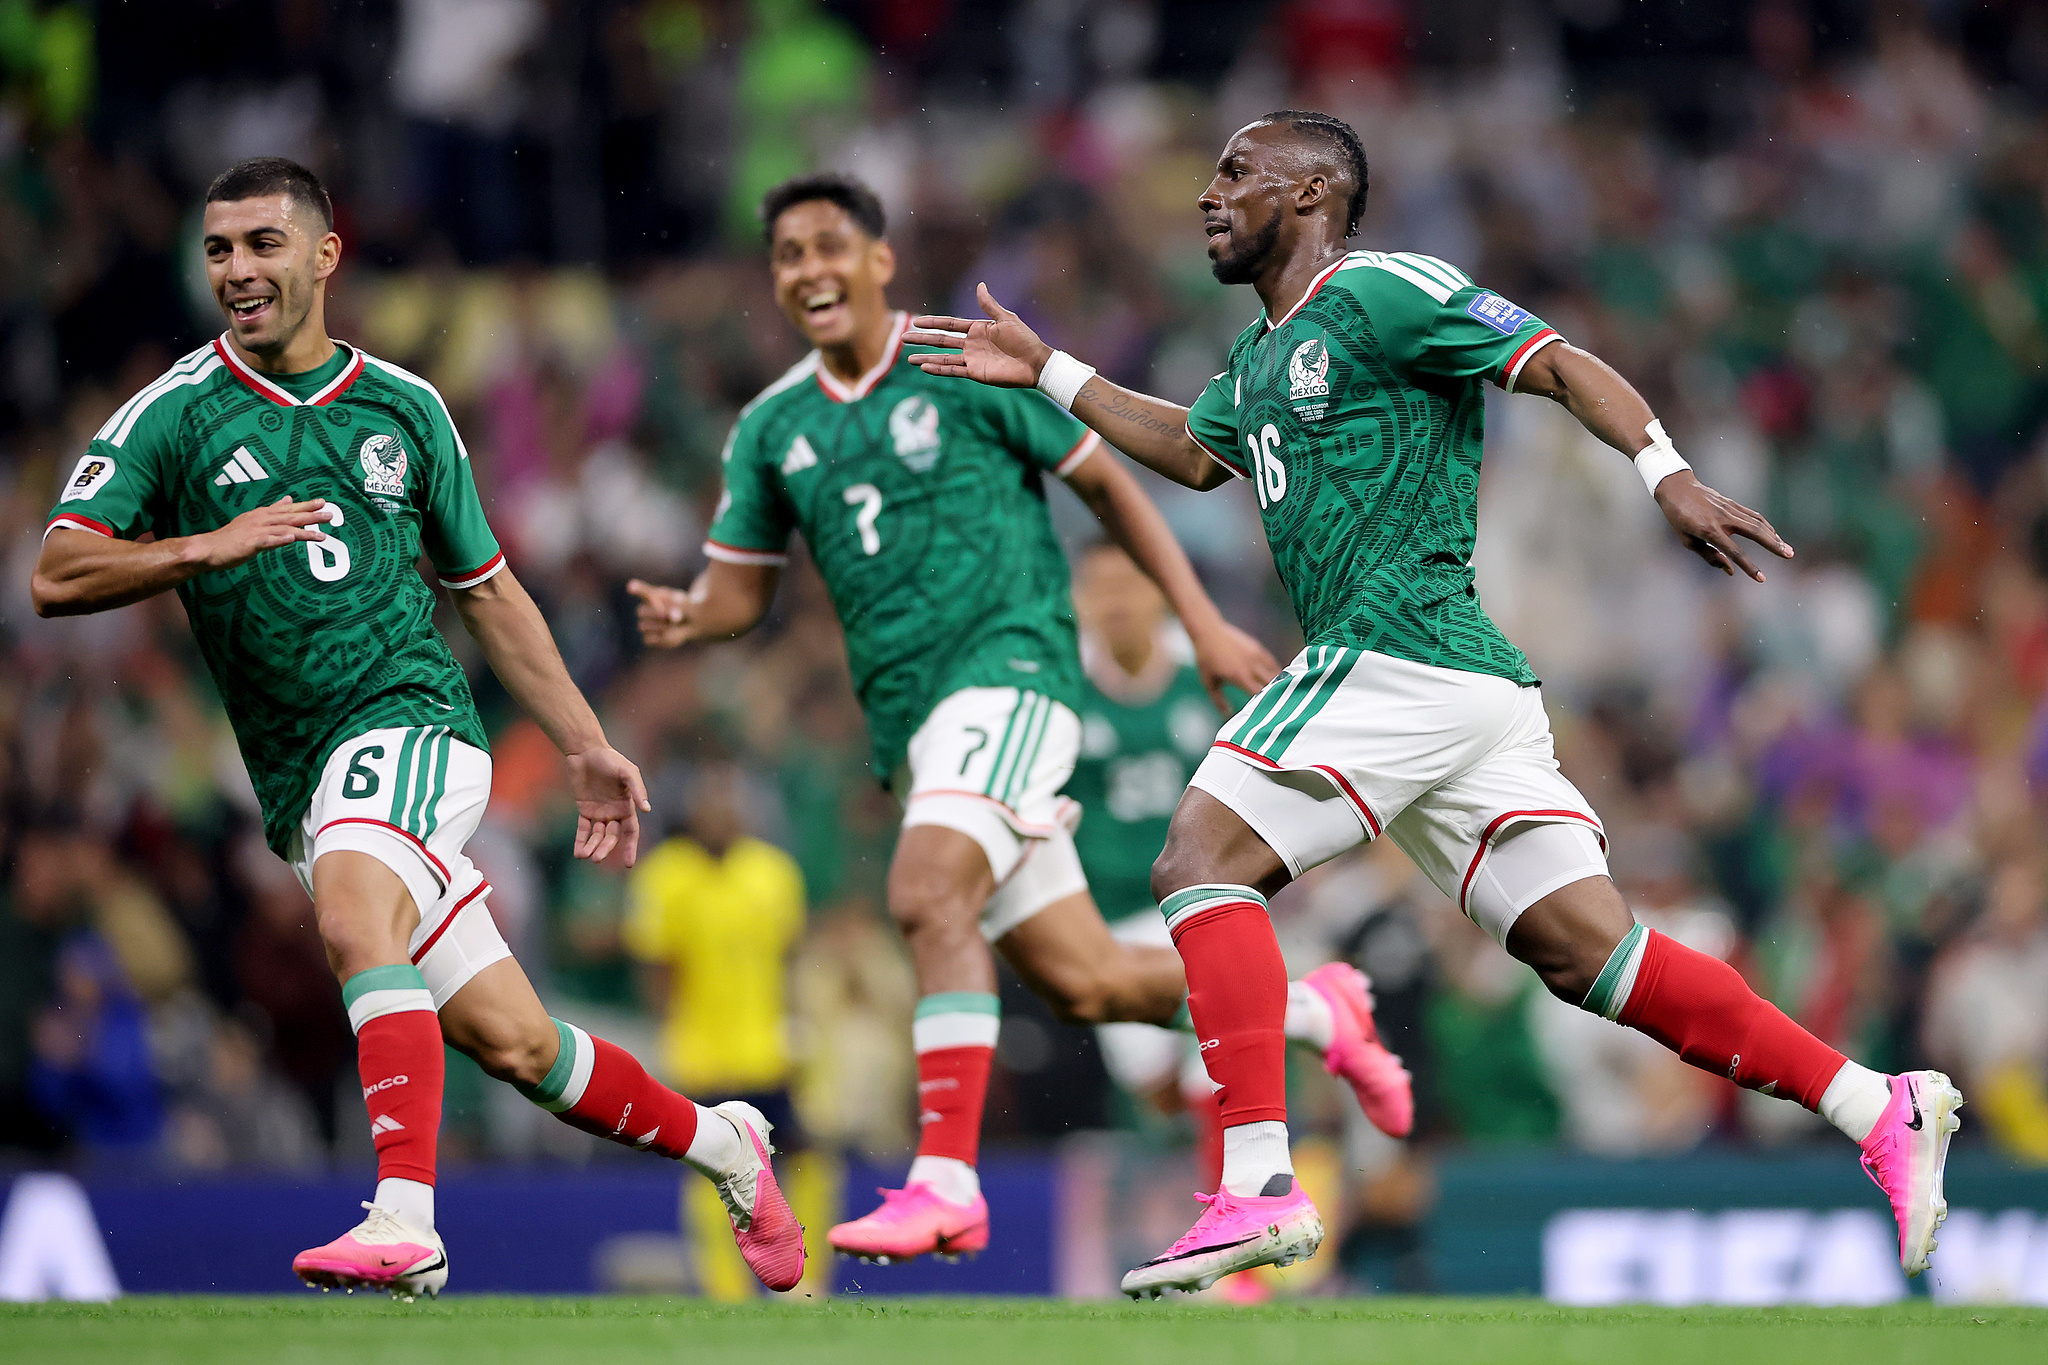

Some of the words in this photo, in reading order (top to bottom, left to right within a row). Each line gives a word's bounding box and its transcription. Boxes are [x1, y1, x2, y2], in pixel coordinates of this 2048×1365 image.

[1290, 385, 1327, 398] MÉXICO
[366, 481, 403, 495] MÉXICO
[1247, 423, 1287, 510] 16
[304, 502, 351, 582] 6
[843, 483, 882, 555] 7
[342, 745, 385, 799] 6
[962, 726, 989, 776] 7
